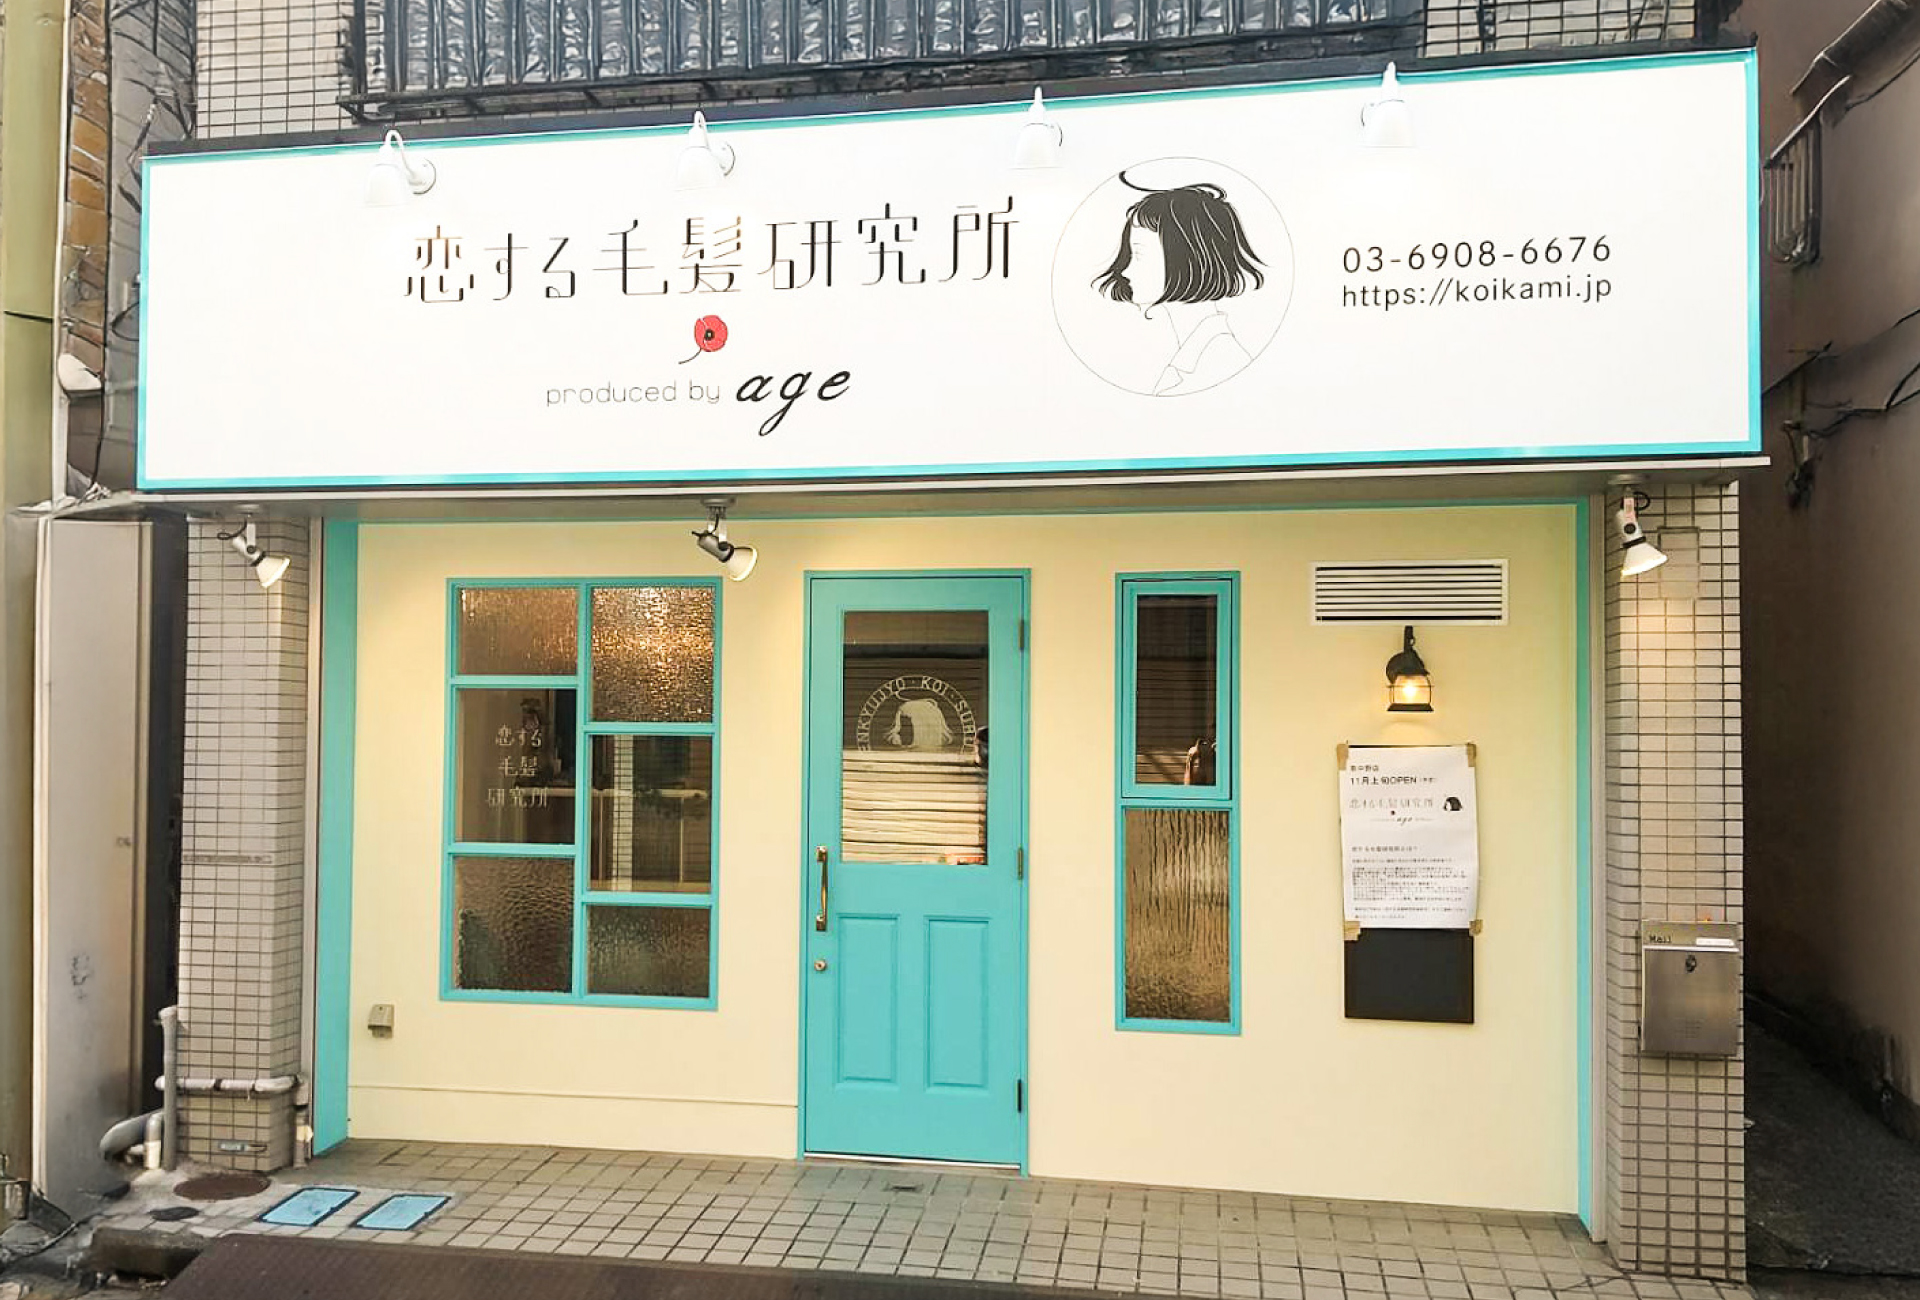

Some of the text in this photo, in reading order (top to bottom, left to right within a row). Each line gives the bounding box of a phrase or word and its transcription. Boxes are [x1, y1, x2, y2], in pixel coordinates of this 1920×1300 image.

[404, 195, 1019, 303] 恋する毛髪研究所
[1342, 235, 1611, 273] 03-6908-6676
[1342, 273, 1613, 311] https://koikami.jp
[546, 370, 851, 437] produced by age
[495, 723, 542, 748] 恋する
[485, 785, 549, 808] 研究所
